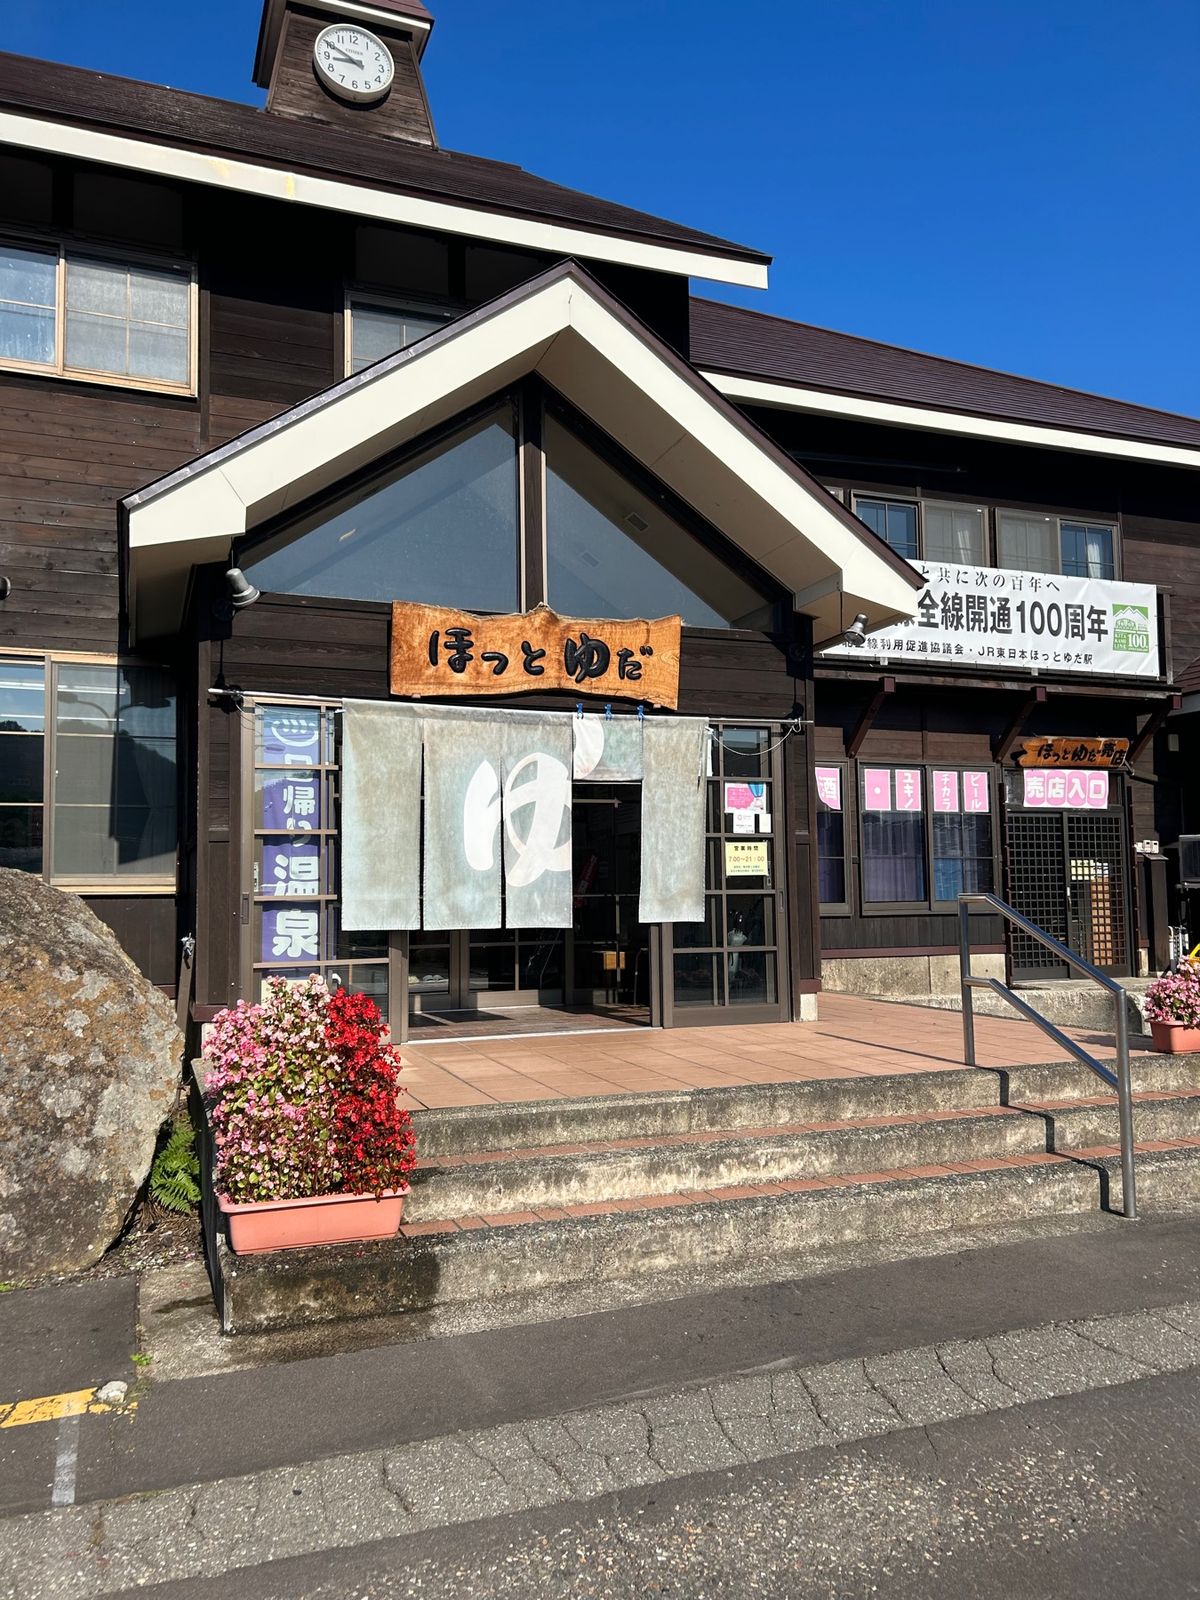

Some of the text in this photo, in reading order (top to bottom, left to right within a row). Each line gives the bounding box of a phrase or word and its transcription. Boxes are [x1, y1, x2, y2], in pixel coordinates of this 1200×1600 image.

[337, 34, 344, 44] 11
[349, 34, 359, 45] 12
[323, 50, 330, 60] 9
[374, 52, 381, 61] 2
[327, 63, 335, 72] 8
[378, 64, 385, 73] 3
[339, 74, 346, 83] 7
[351, 80, 358, 89] 6
[364, 80, 371, 89] 5
[374, 75, 382, 84] 4
[895, 588, 1109, 642] 全線開通100周年
[428, 627, 653, 683] ほっとゆだ
[842, 637, 1093, 665] 線利用促進協議会・JR東日本ほっとゆだ駅
[1037, 742, 1127, 765] ほっとゆだ売店
[819, 775, 838, 800] 酒
[902, 772, 915, 809] ユキノ
[941, 773, 952, 810] チカラ
[970, 773, 982, 810] ビール
[1026, 776, 1106, 800] 売店入口
[271, 753, 319, 958] 日帰り温泉
